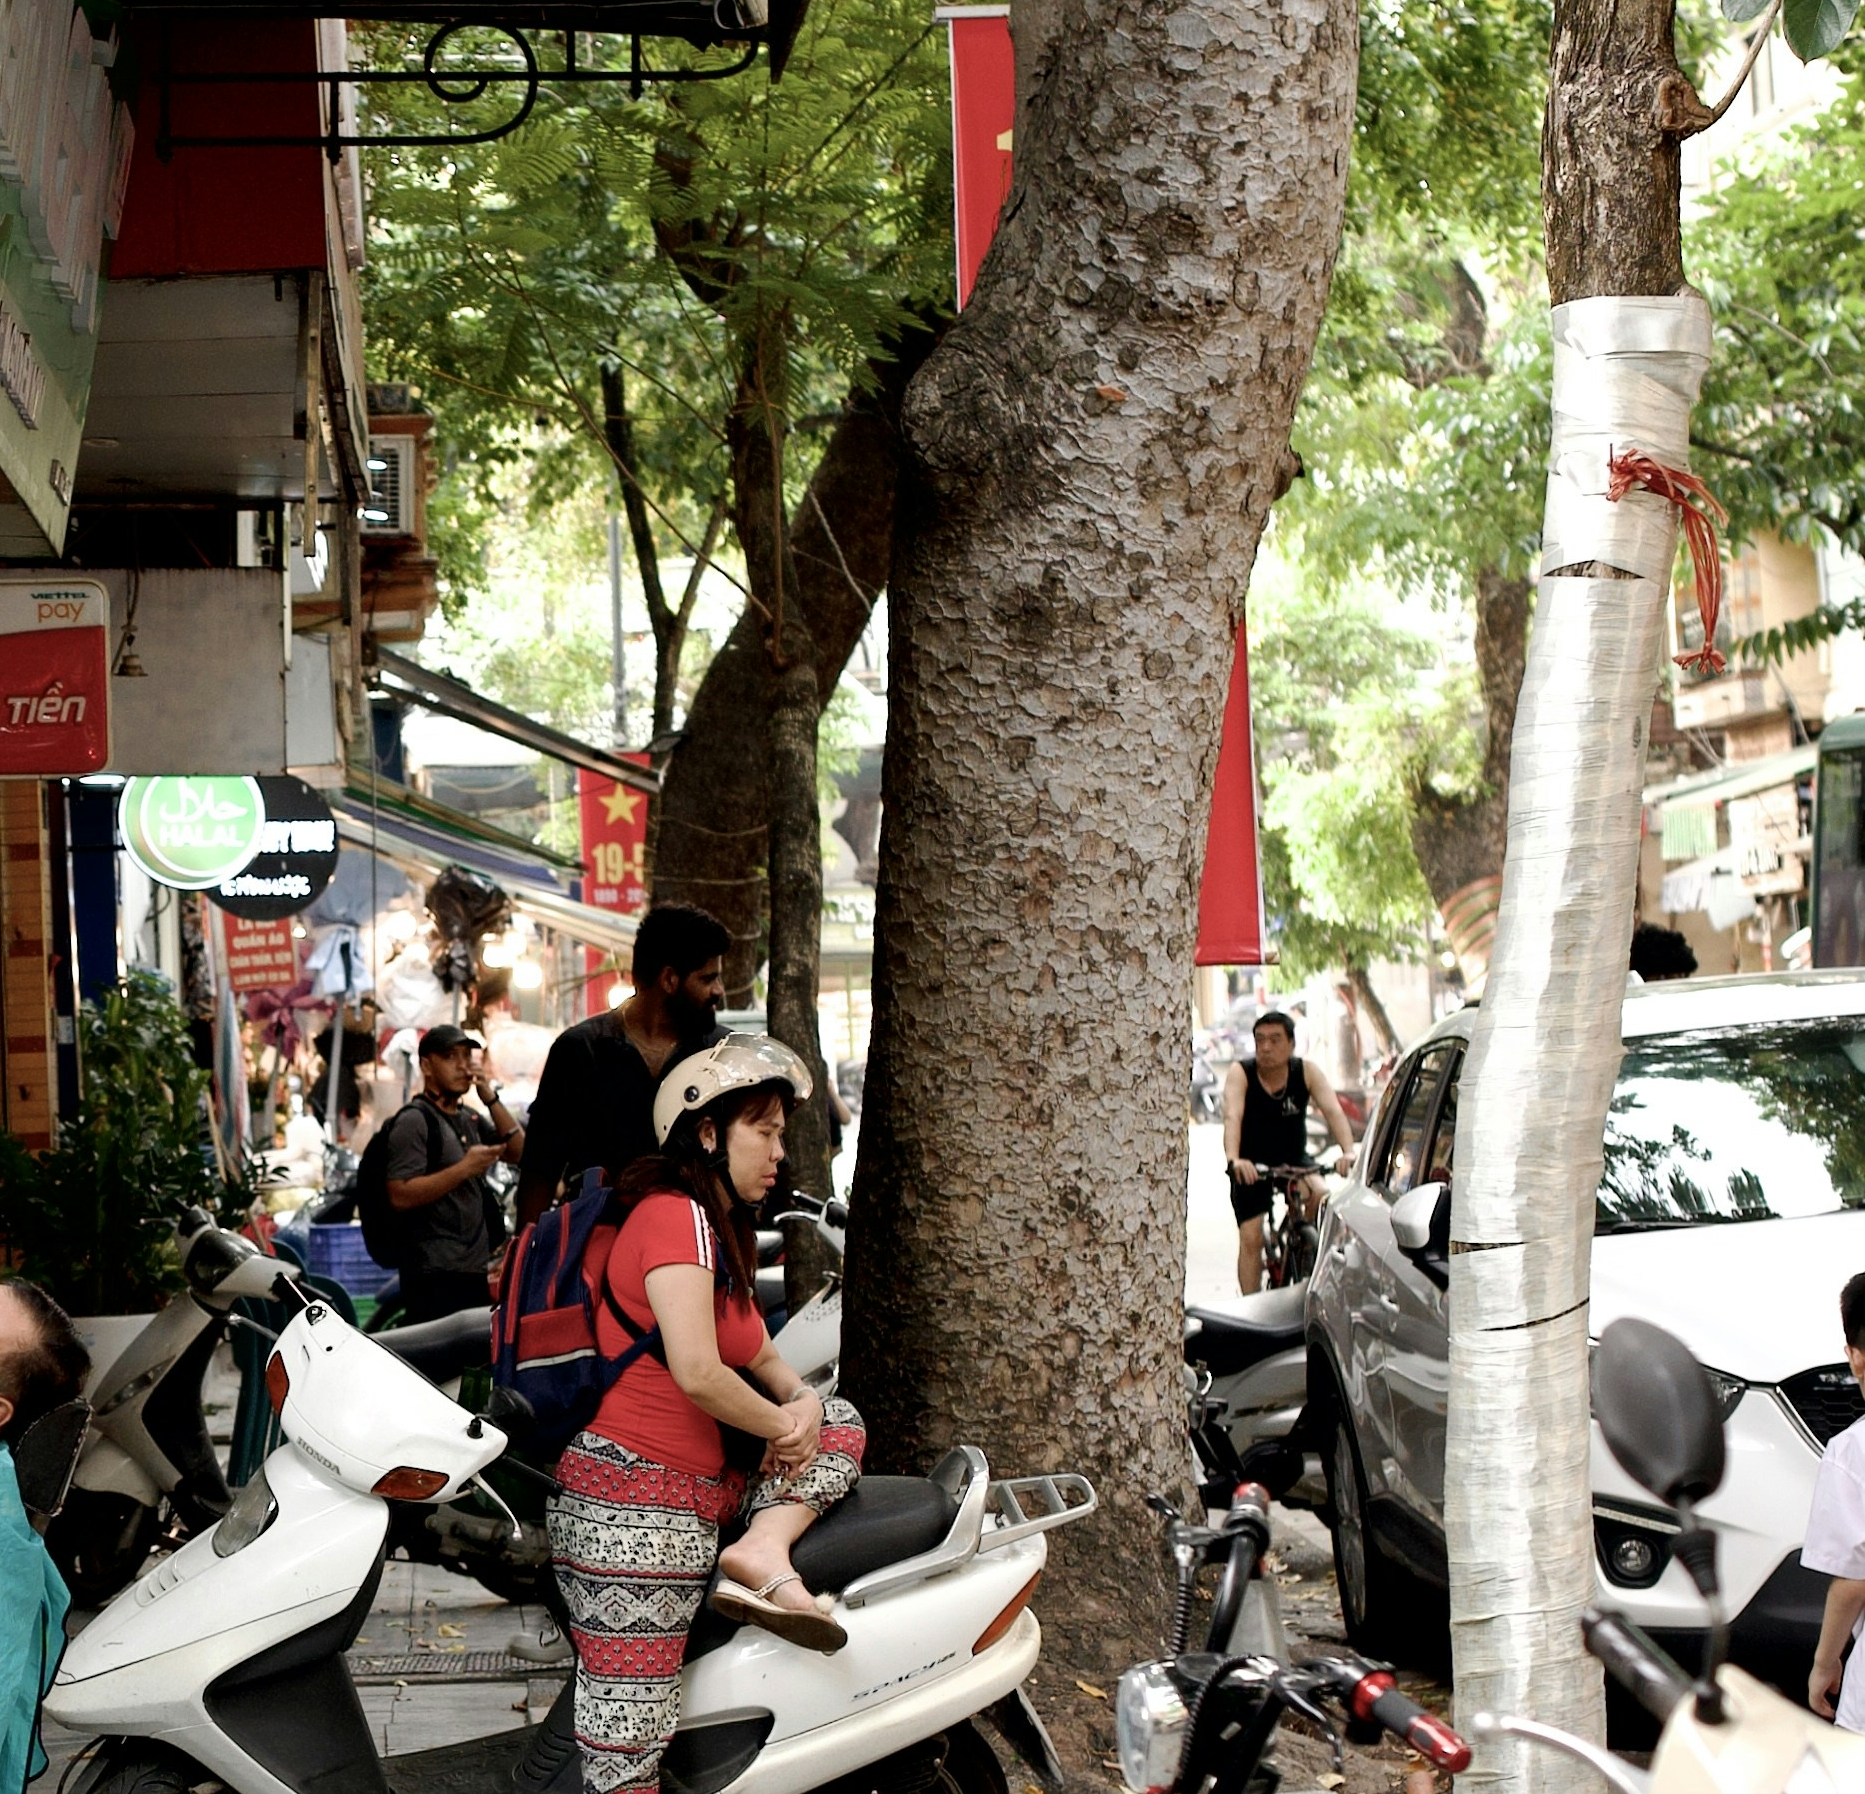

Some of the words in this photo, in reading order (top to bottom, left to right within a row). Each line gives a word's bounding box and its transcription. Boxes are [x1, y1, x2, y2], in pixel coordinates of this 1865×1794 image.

[37, 601, 85, 623] pay
[158, 824, 246, 848] HALAL
[296, 1436, 342, 1476] HONDA
